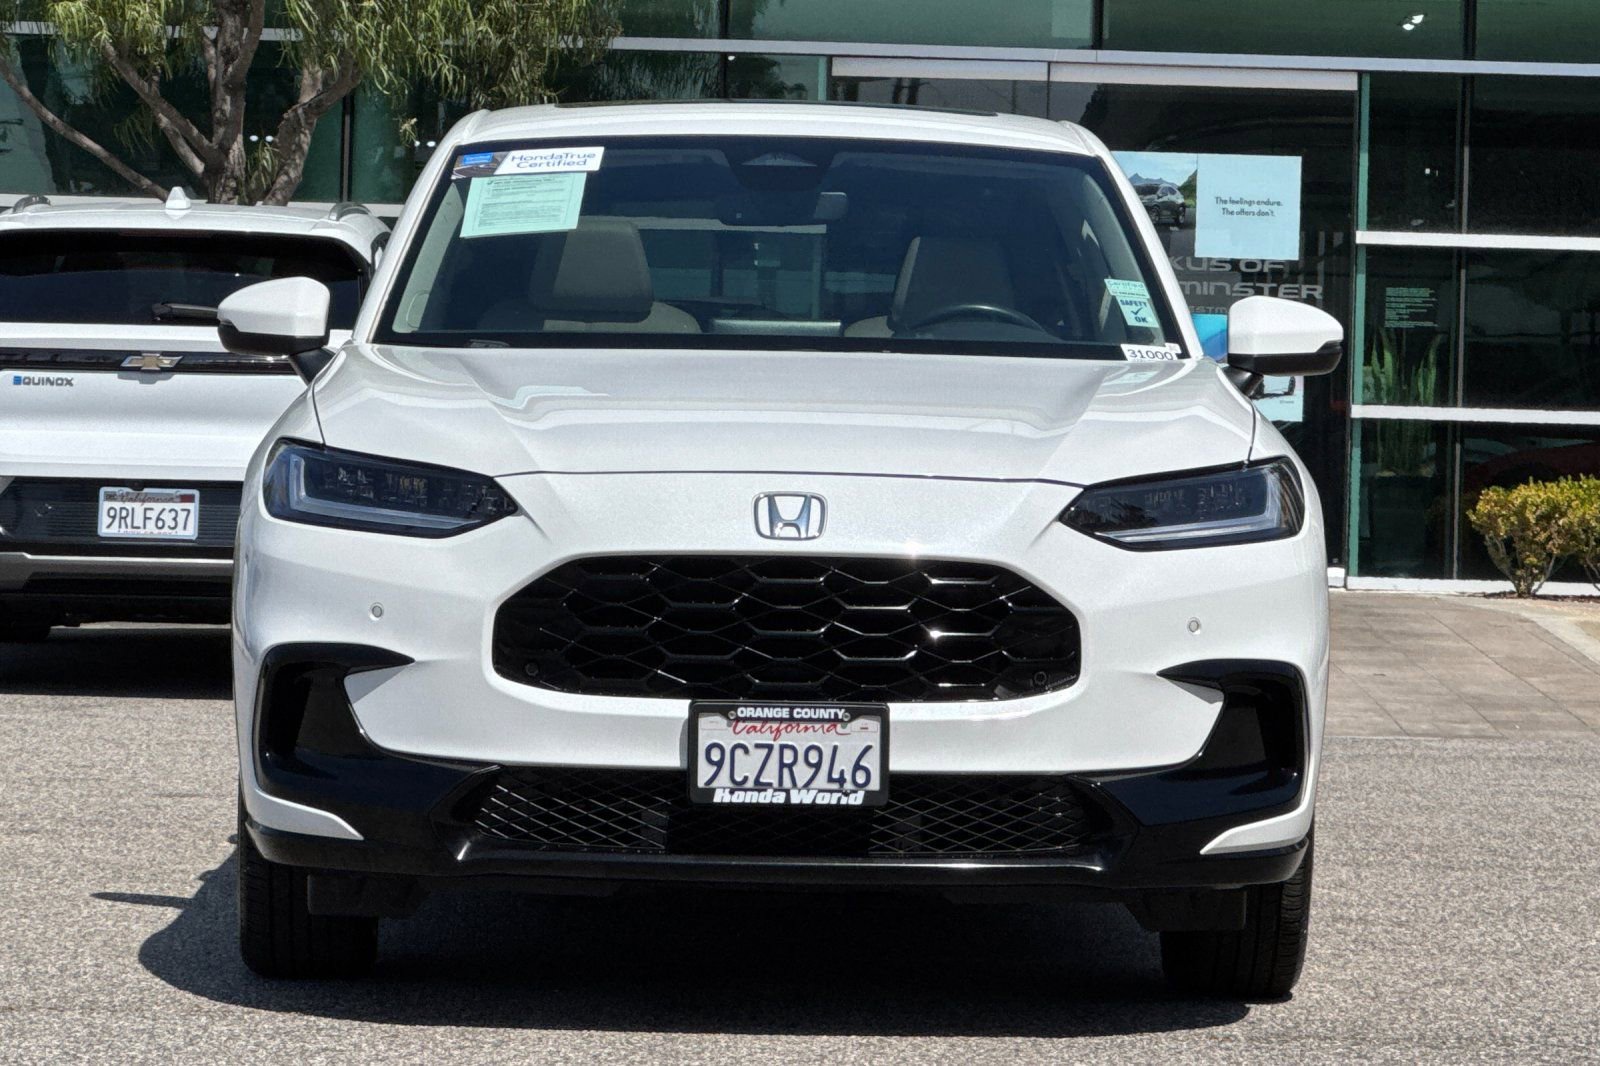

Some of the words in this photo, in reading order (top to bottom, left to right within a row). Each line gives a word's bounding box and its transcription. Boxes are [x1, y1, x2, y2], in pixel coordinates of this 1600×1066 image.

[512, 152, 596, 162] HondaTrue
[516, 158, 587, 169] Certified
[1214, 196, 1228, 205] The
[1229, 196, 1256, 207] feelings
[1256, 197, 1284, 207] endure.
[1222, 207, 1235, 216] The
[1236, 208, 1255, 217] offers
[1239, 258, 1285, 273] OF
[1119, 299, 1148, 308] SAFETY
[1134, 316, 1149, 324] OK
[1127, 348, 1174, 361] 31000
[13, 375, 75, 388] EQUINOX
[105, 506, 192, 532] 9RLF637
[737, 707, 790, 719] ORANGE
[793, 708, 844, 720] COUNTY
[731, 720, 852, 742] California
[704, 742, 873, 789] 9CZR946
[713, 788, 786, 804] Honda
[790, 790, 865, 805] World
